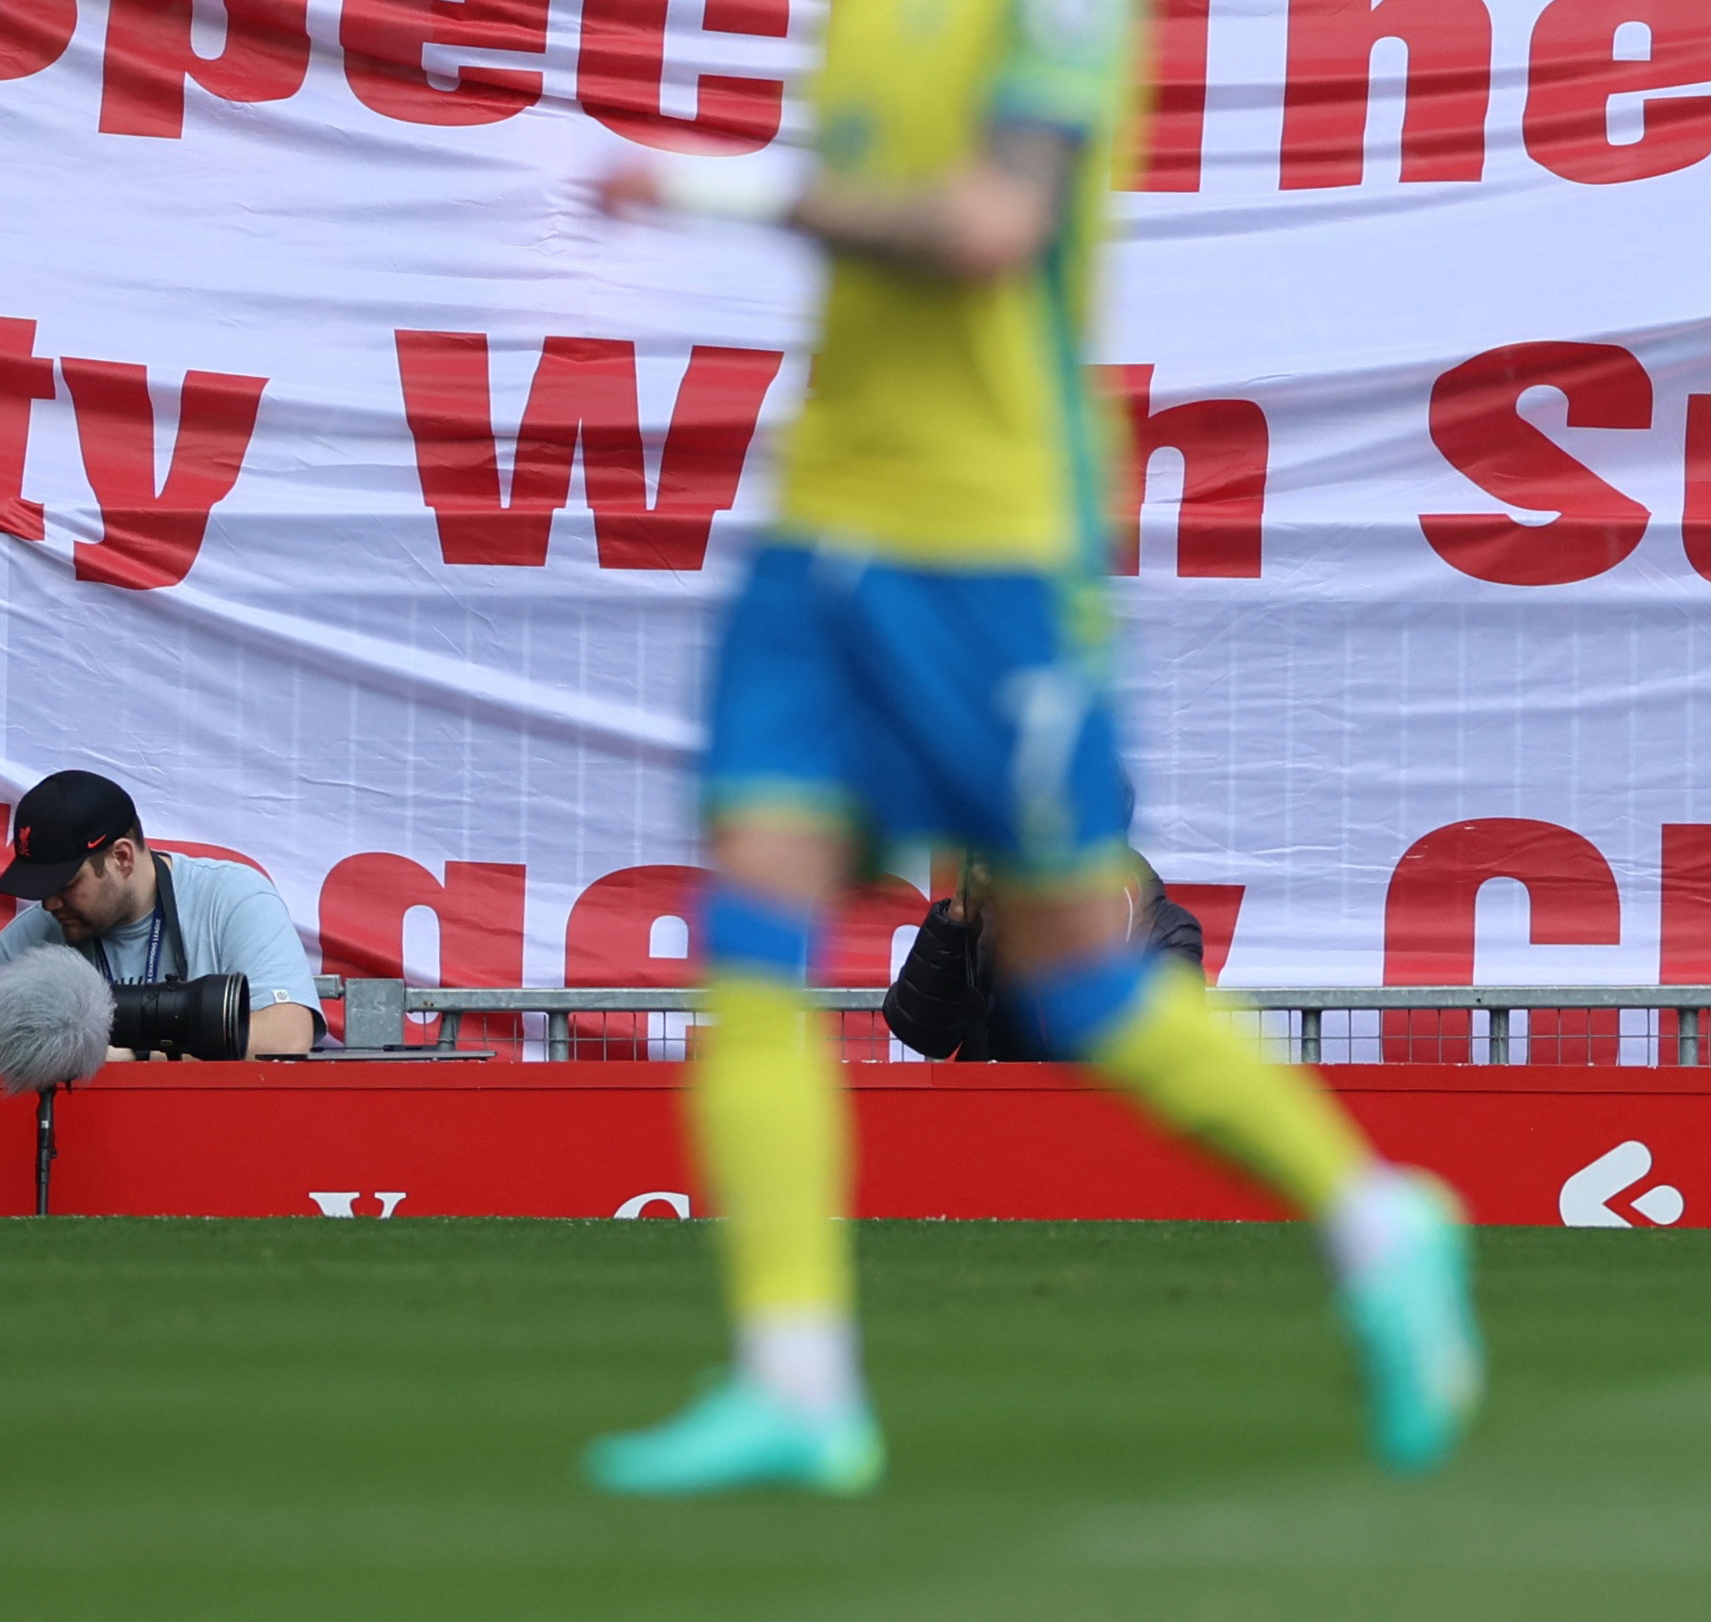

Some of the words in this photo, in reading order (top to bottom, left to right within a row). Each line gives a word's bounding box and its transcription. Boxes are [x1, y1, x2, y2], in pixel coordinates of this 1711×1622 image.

[394, 330, 1270, 581] Wh
[152, 918, 162, 941] LEAGUE
[147, 942, 158, 978] CHAMPIONS
